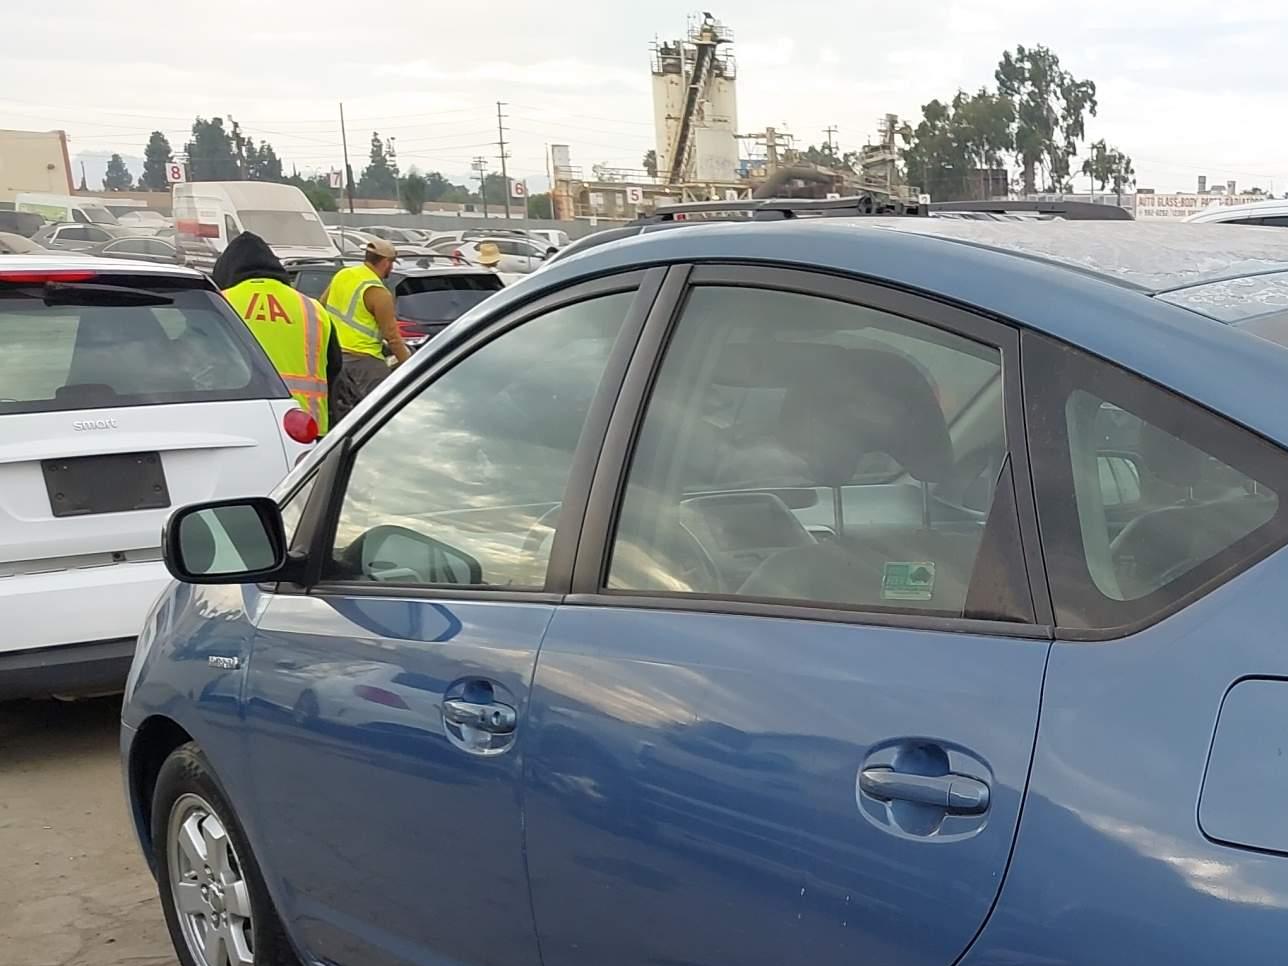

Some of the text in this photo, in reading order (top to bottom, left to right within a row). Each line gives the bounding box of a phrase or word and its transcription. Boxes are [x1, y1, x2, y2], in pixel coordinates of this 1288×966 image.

[171, 166, 181, 180] 8
[332, 173, 341, 187] 7
[515, 182, 524, 195] 6
[631, 190, 639, 201] 5
[72, 417, 119, 432] smart
